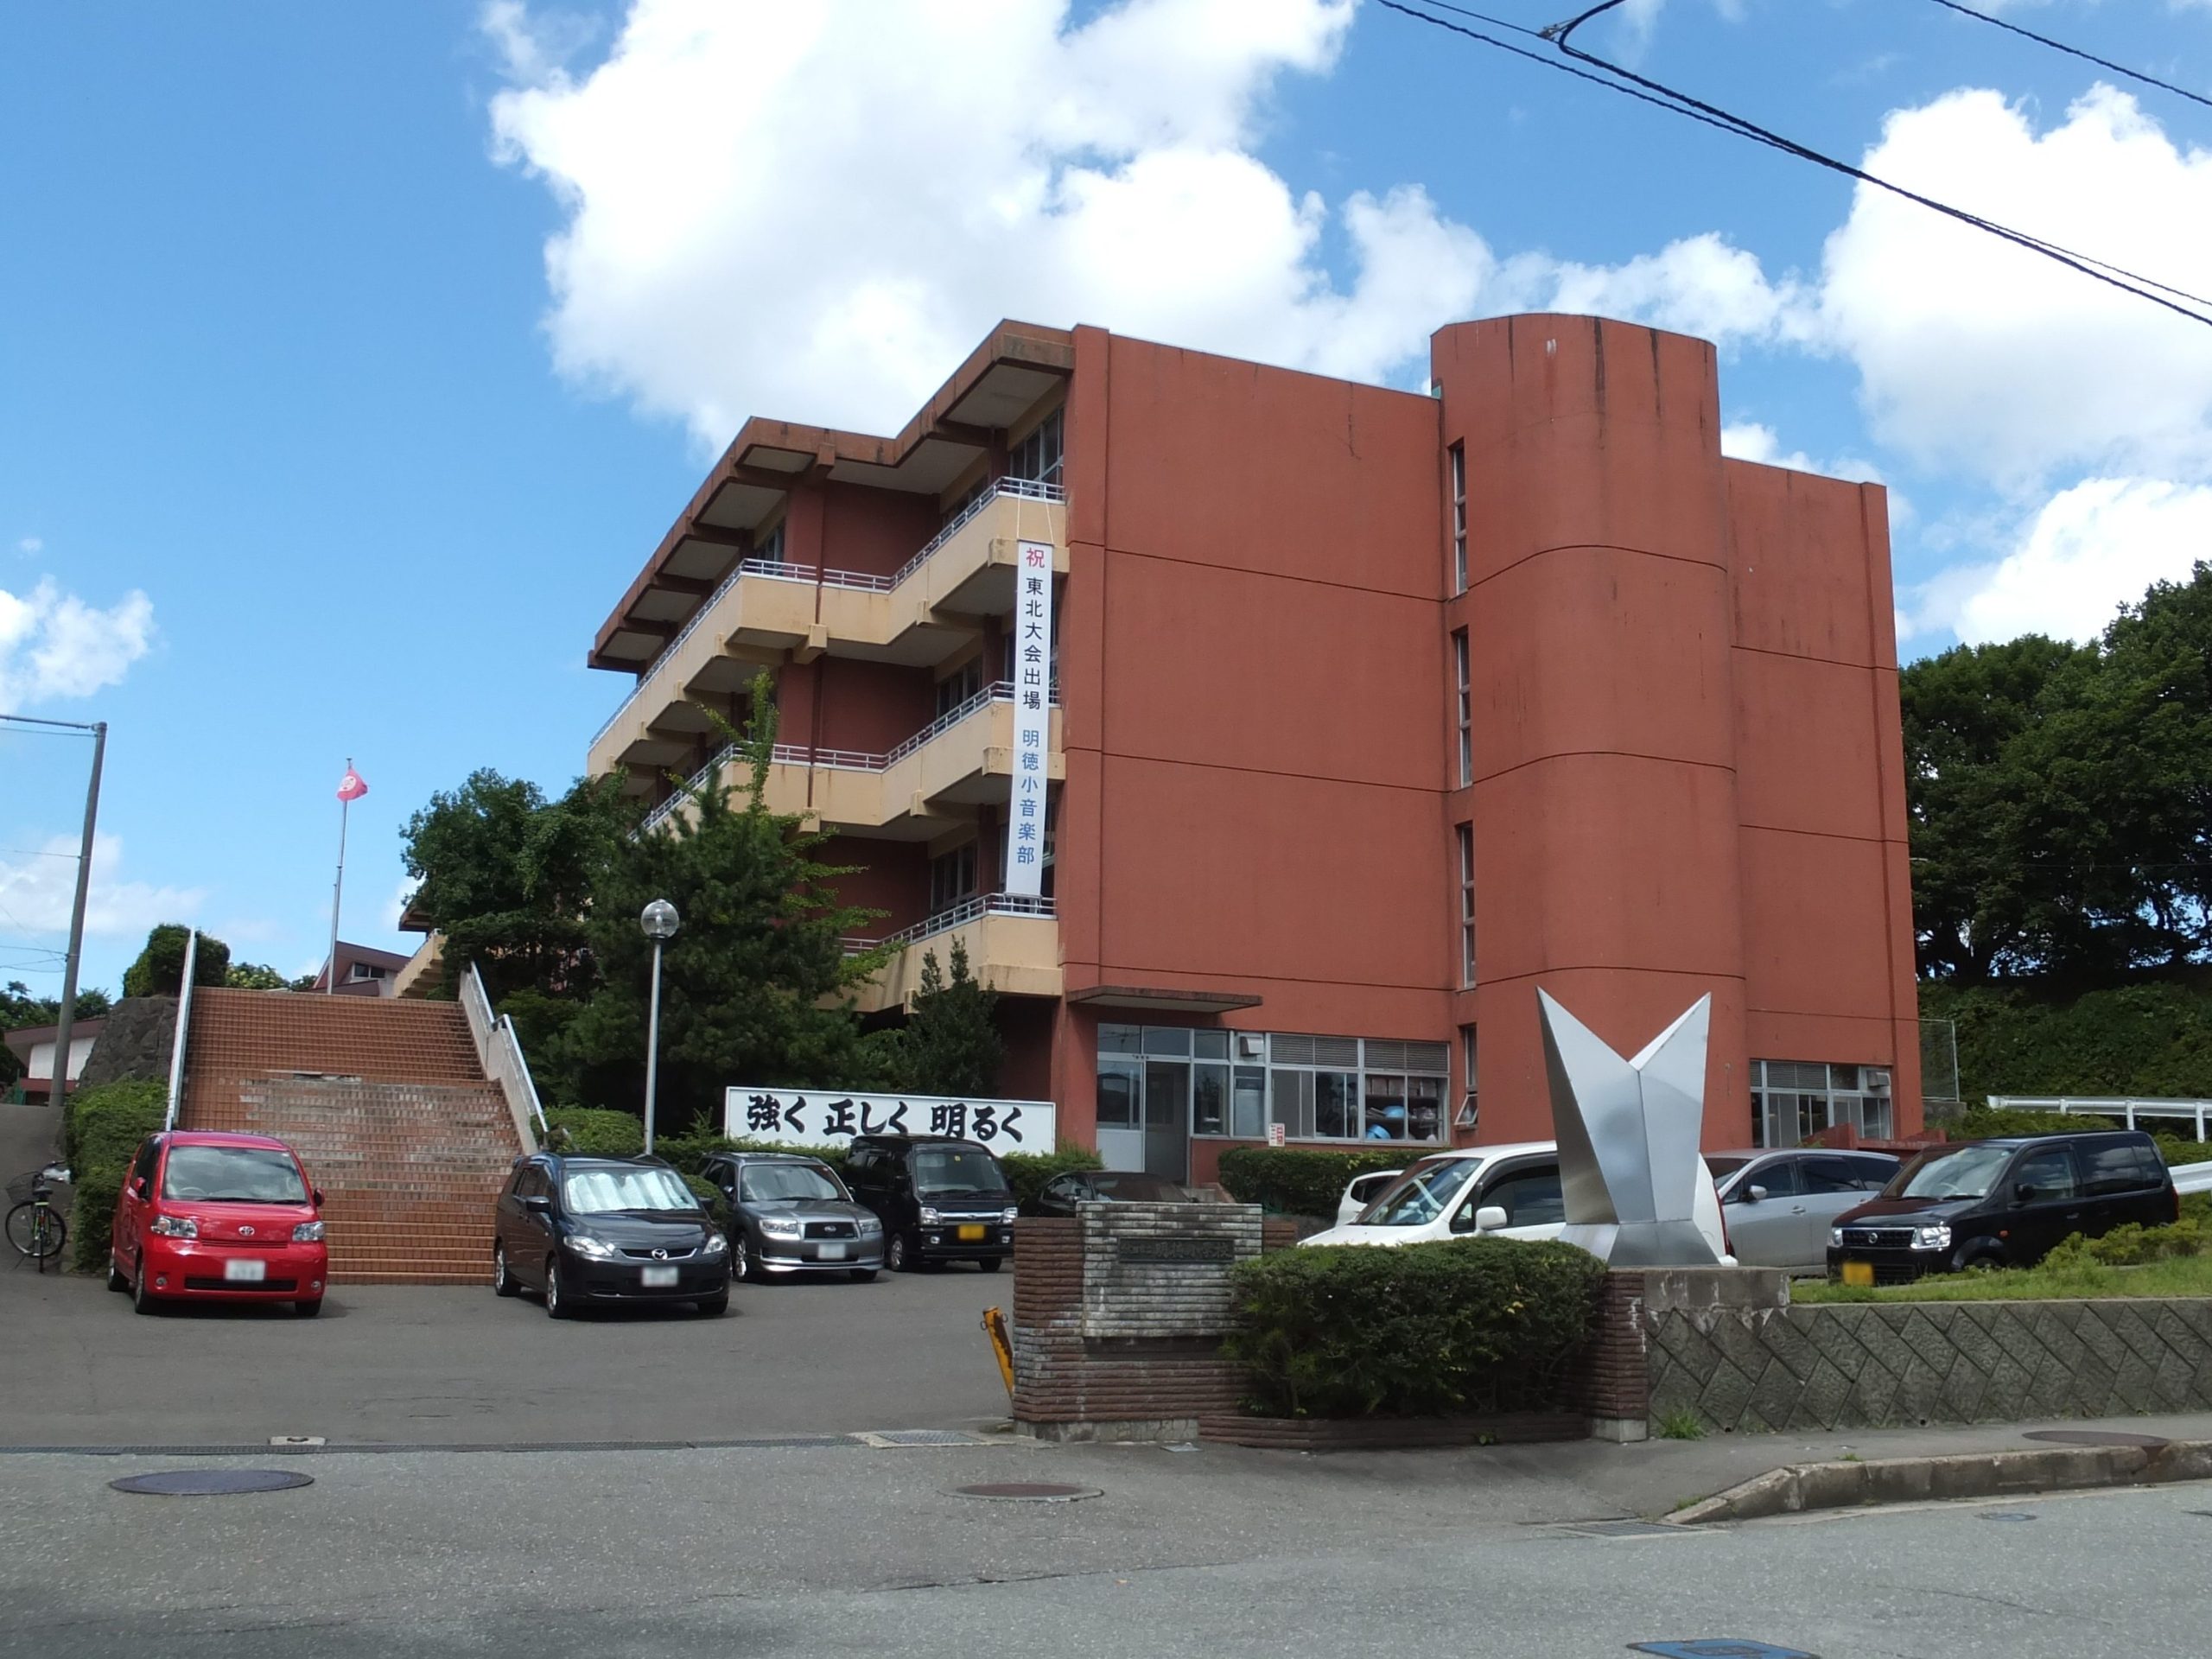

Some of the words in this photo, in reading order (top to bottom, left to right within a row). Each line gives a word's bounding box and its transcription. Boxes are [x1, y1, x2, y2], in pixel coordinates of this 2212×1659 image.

[1026, 547, 1045, 569] 祝
[1023, 576, 1044, 709] 東北大会出場
[1017, 729, 1039, 865] 明徳小音楽部
[747, 1094, 807, 1134] 強く
[823, 1099, 909, 1136] 正しく
[931, 1102, 1022, 1142] 明るく
